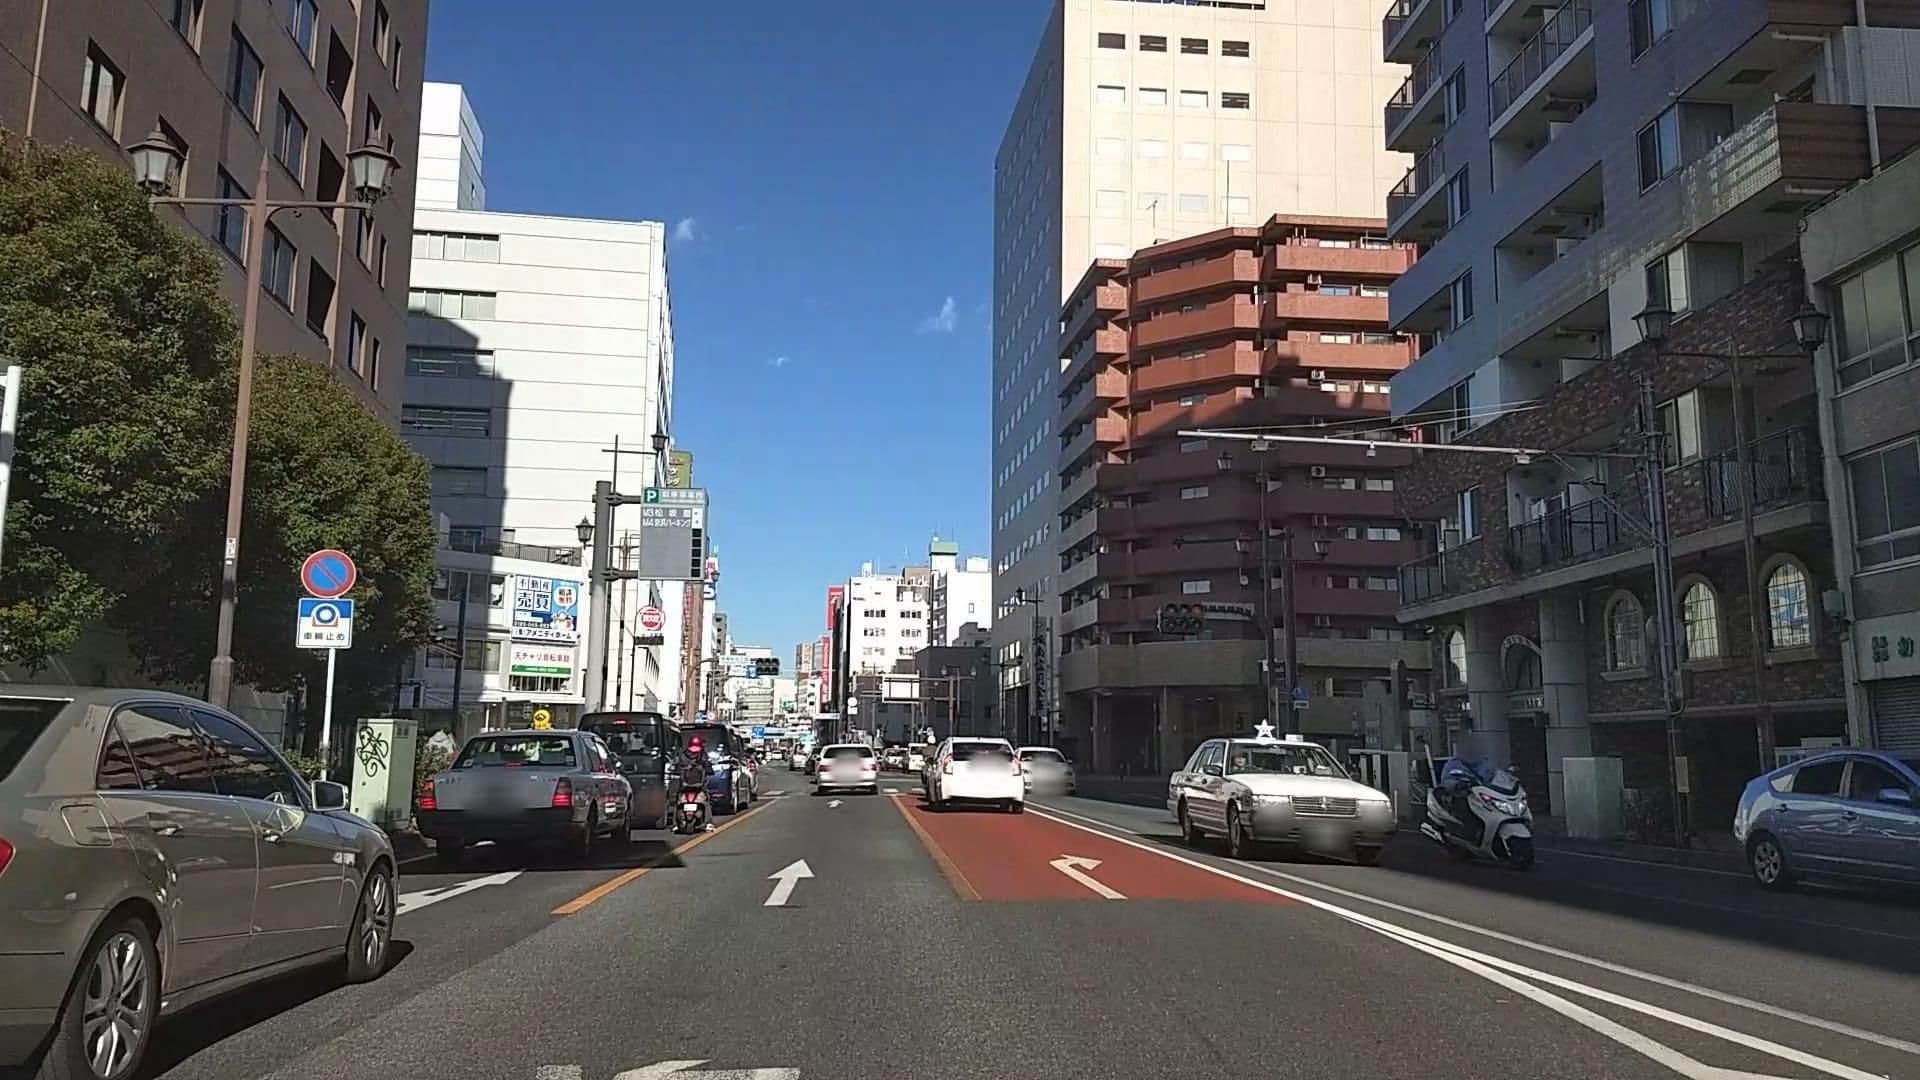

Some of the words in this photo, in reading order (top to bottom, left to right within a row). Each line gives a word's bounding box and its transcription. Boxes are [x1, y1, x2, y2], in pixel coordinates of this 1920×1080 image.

[646, 490, 657, 502] P
[517, 592, 550, 610] 売買
[303, 631, 345, 641] 車輪止め
